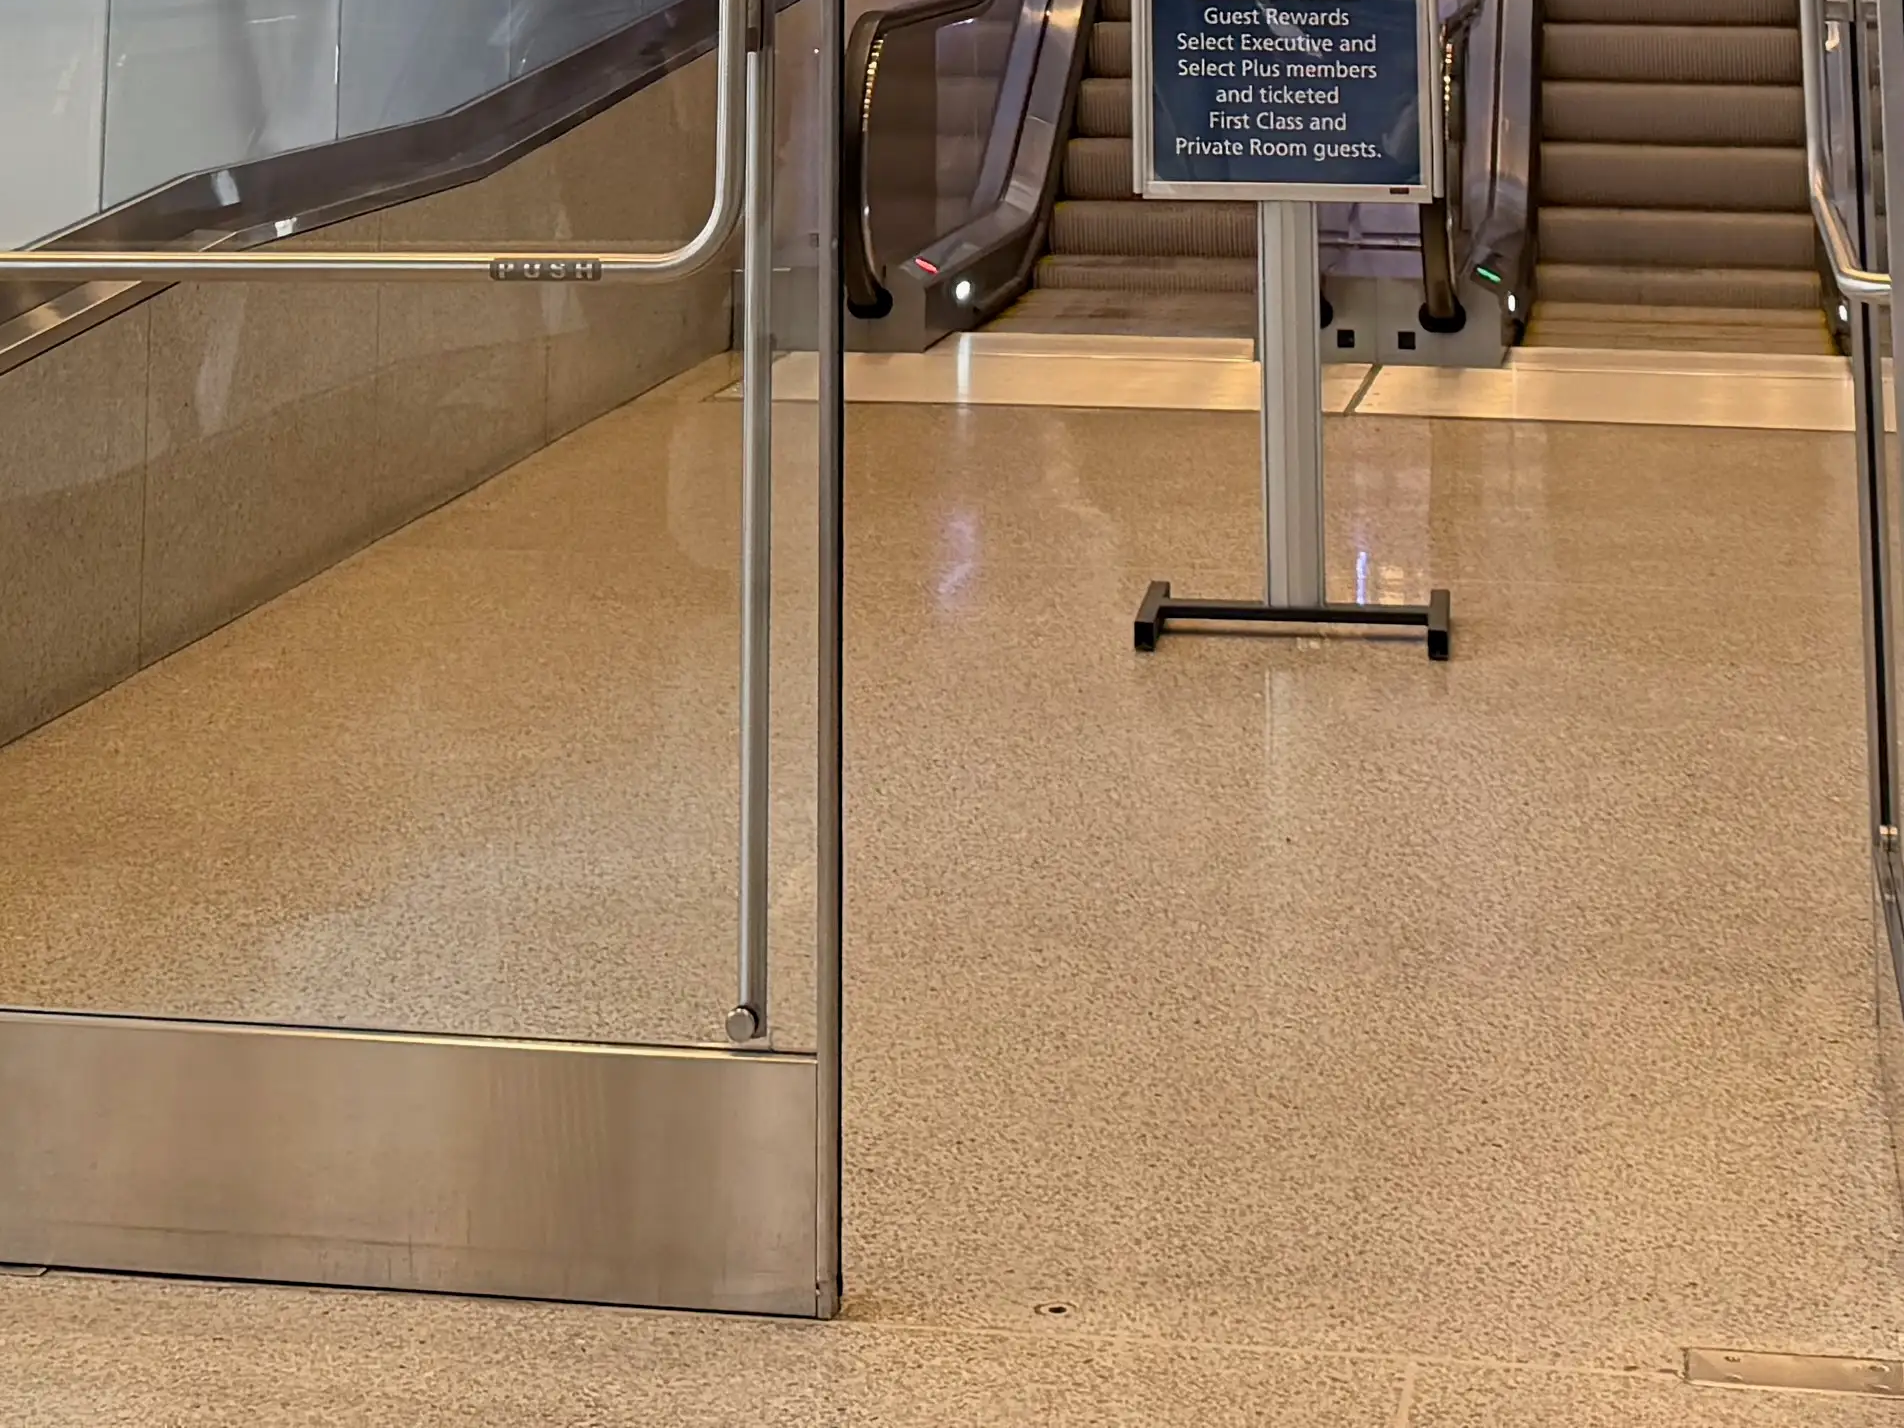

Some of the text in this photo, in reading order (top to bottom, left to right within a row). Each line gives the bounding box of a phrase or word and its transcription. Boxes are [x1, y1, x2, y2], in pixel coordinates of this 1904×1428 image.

[1204, 7, 1350, 26] Guest Rewards
[1177, 32, 1377, 53] Select Executive and
[1178, 58, 1377, 79] Select Plus members
[1215, 85, 1340, 105] and ticketed
[1209, 111, 1347, 131] First Class and
[1175, 136, 1382, 162] Private Room guests.
[498, 263, 593, 279] PUSH
